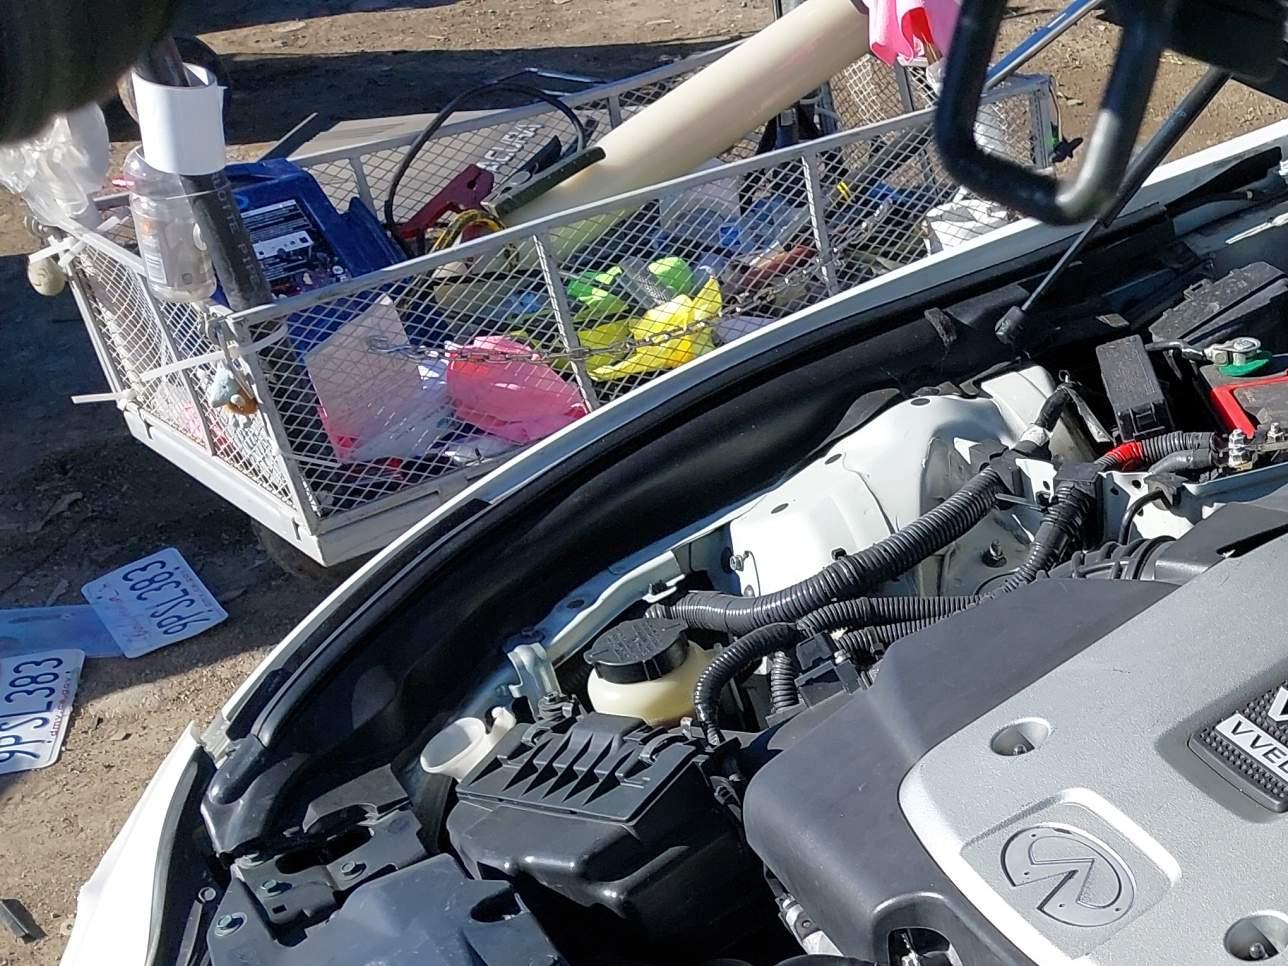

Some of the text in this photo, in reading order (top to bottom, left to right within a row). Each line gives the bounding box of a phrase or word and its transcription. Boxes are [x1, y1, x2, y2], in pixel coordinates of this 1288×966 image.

[476, 124, 544, 172] ACURA
[122, 560, 210, 635] 9PSL383
[0, 658, 63, 763] 9PSL383
